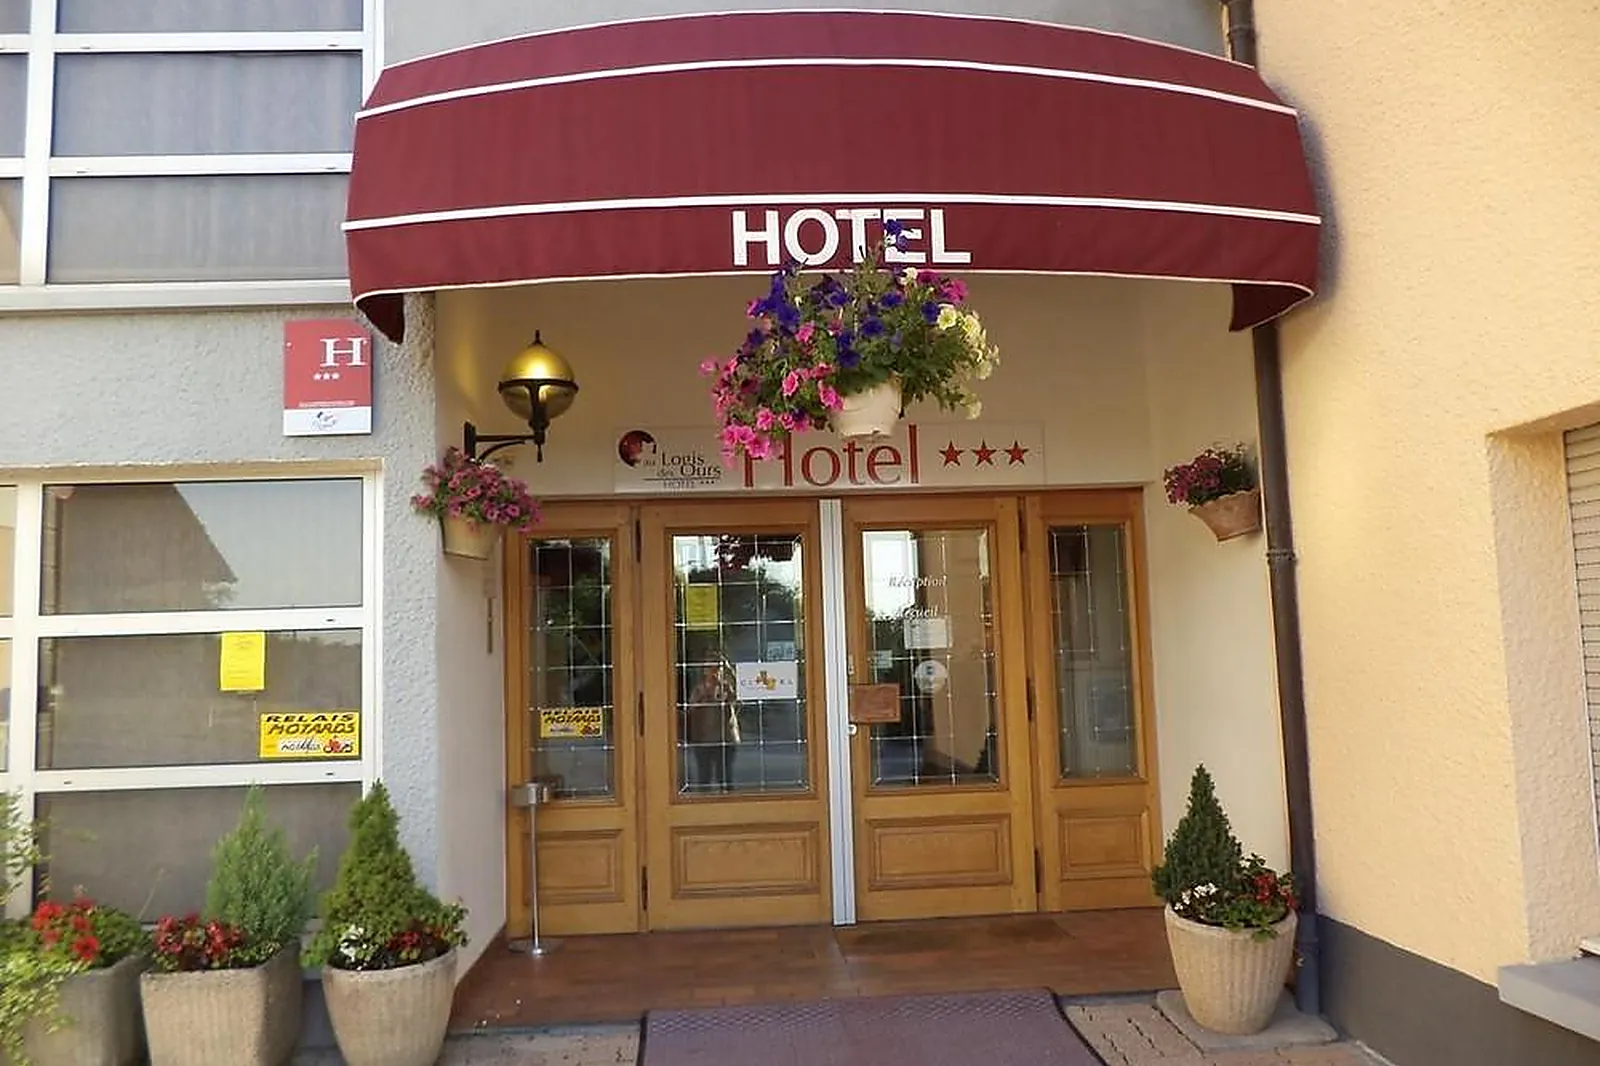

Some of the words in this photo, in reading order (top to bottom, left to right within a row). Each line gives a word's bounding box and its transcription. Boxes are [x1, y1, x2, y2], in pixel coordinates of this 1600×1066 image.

[732, 208, 971, 266] HOTEL
[319, 337, 368, 367] H
[661, 452, 705, 467] Logis
[742, 424, 920, 487] Hotel
[680, 463, 722, 477] Ours
[266, 714, 354, 723] RELAIS
[268, 722, 356, 735] MOTARDS
